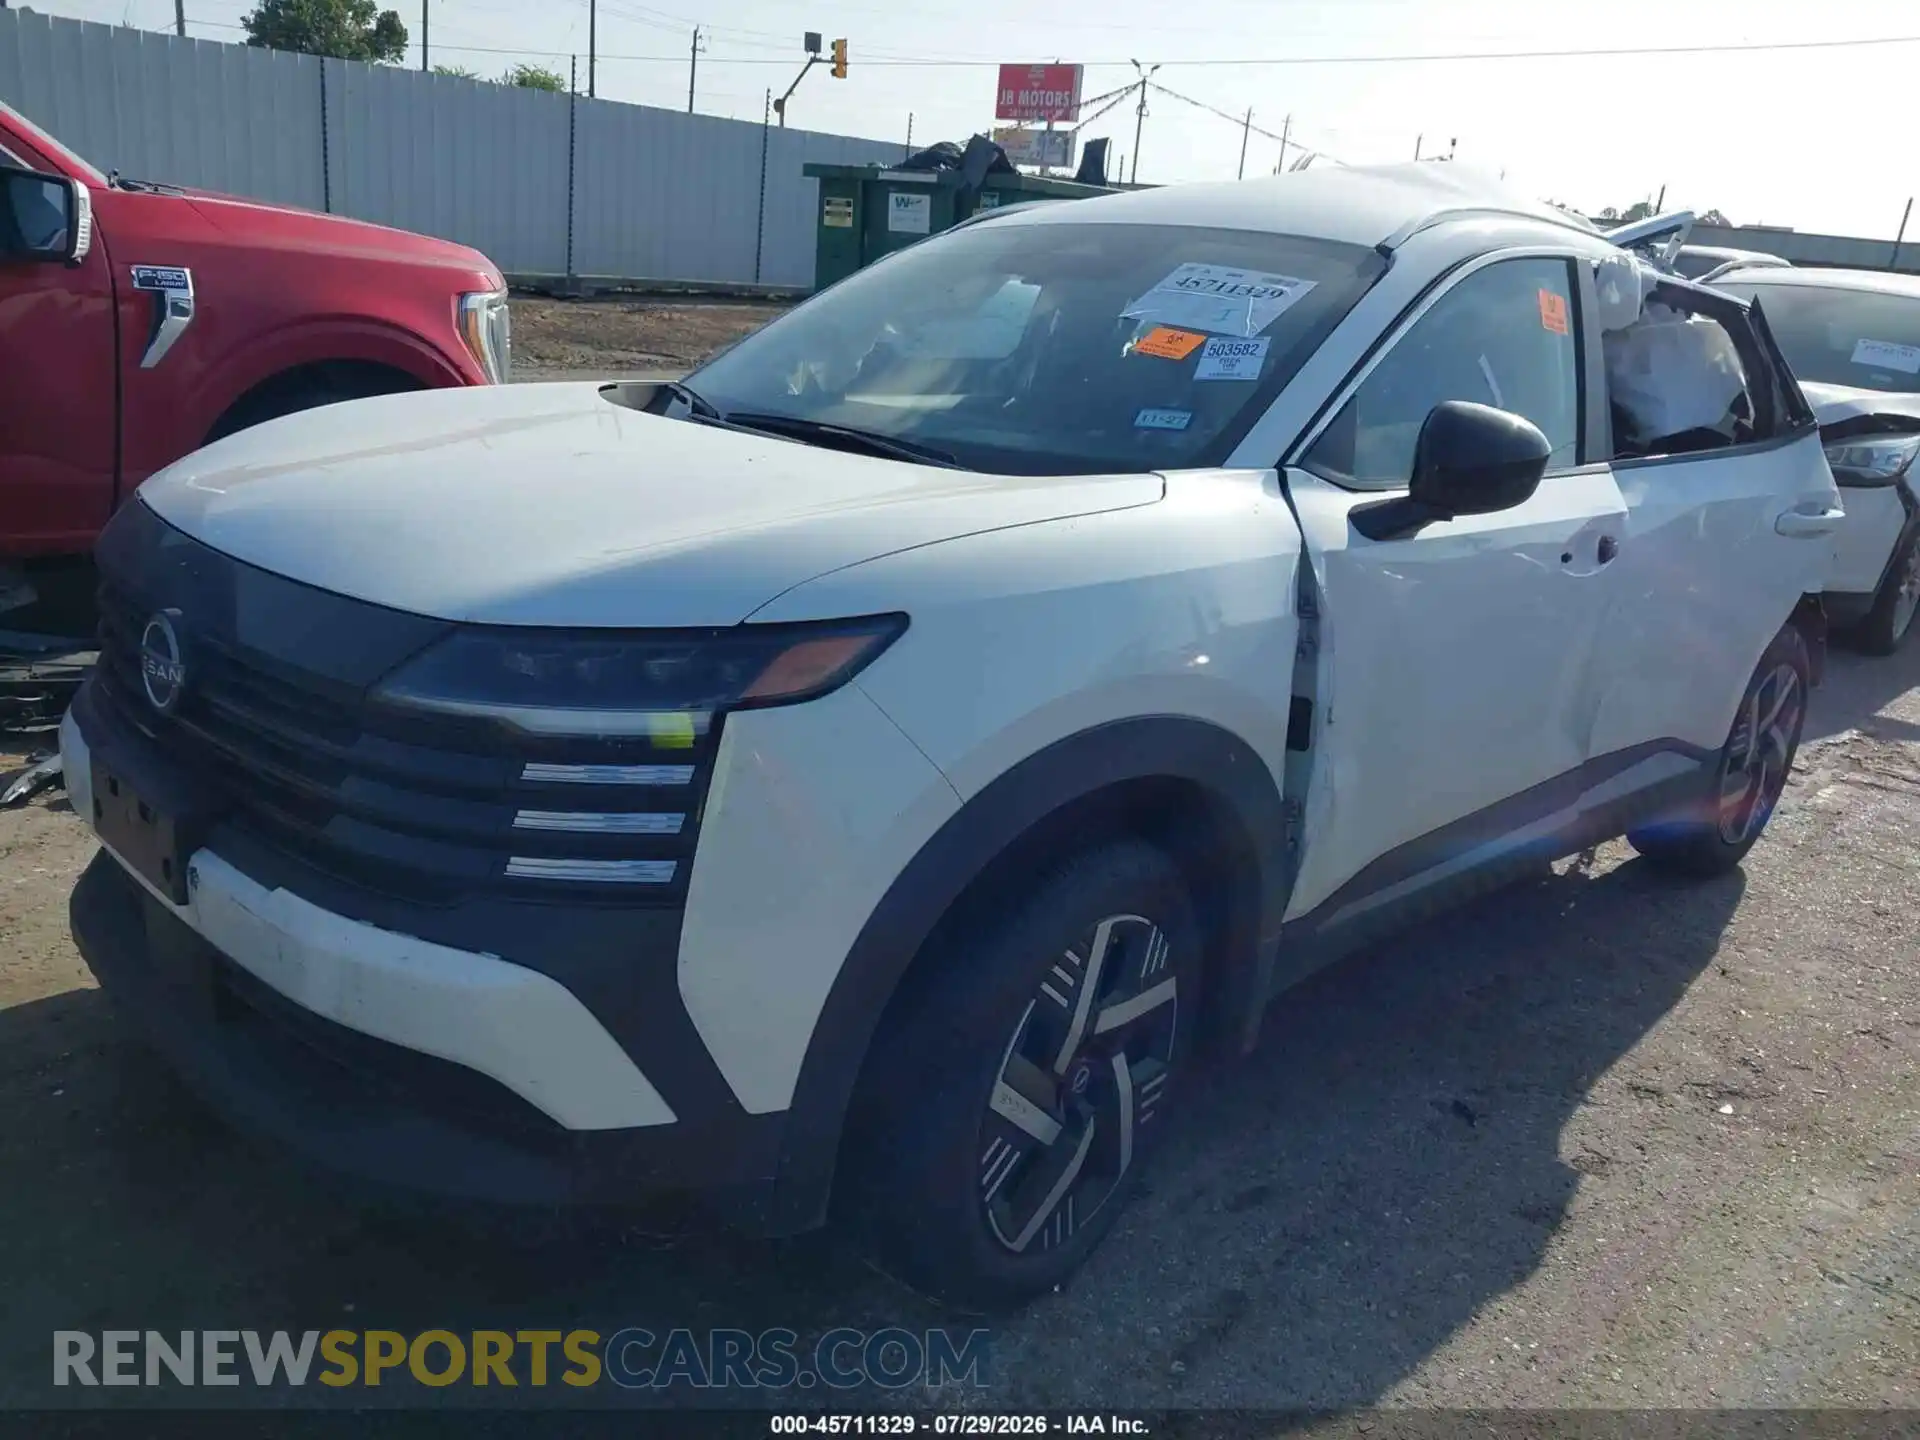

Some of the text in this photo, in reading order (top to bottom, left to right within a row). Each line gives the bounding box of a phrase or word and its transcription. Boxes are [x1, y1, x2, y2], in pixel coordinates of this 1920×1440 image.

[1000, 88, 1071, 107] JB MOTORS
[139, 270, 185, 281] F-150
[1176, 276, 1285, 299] 45711329
[1207, 344, 1260, 356] 503582
